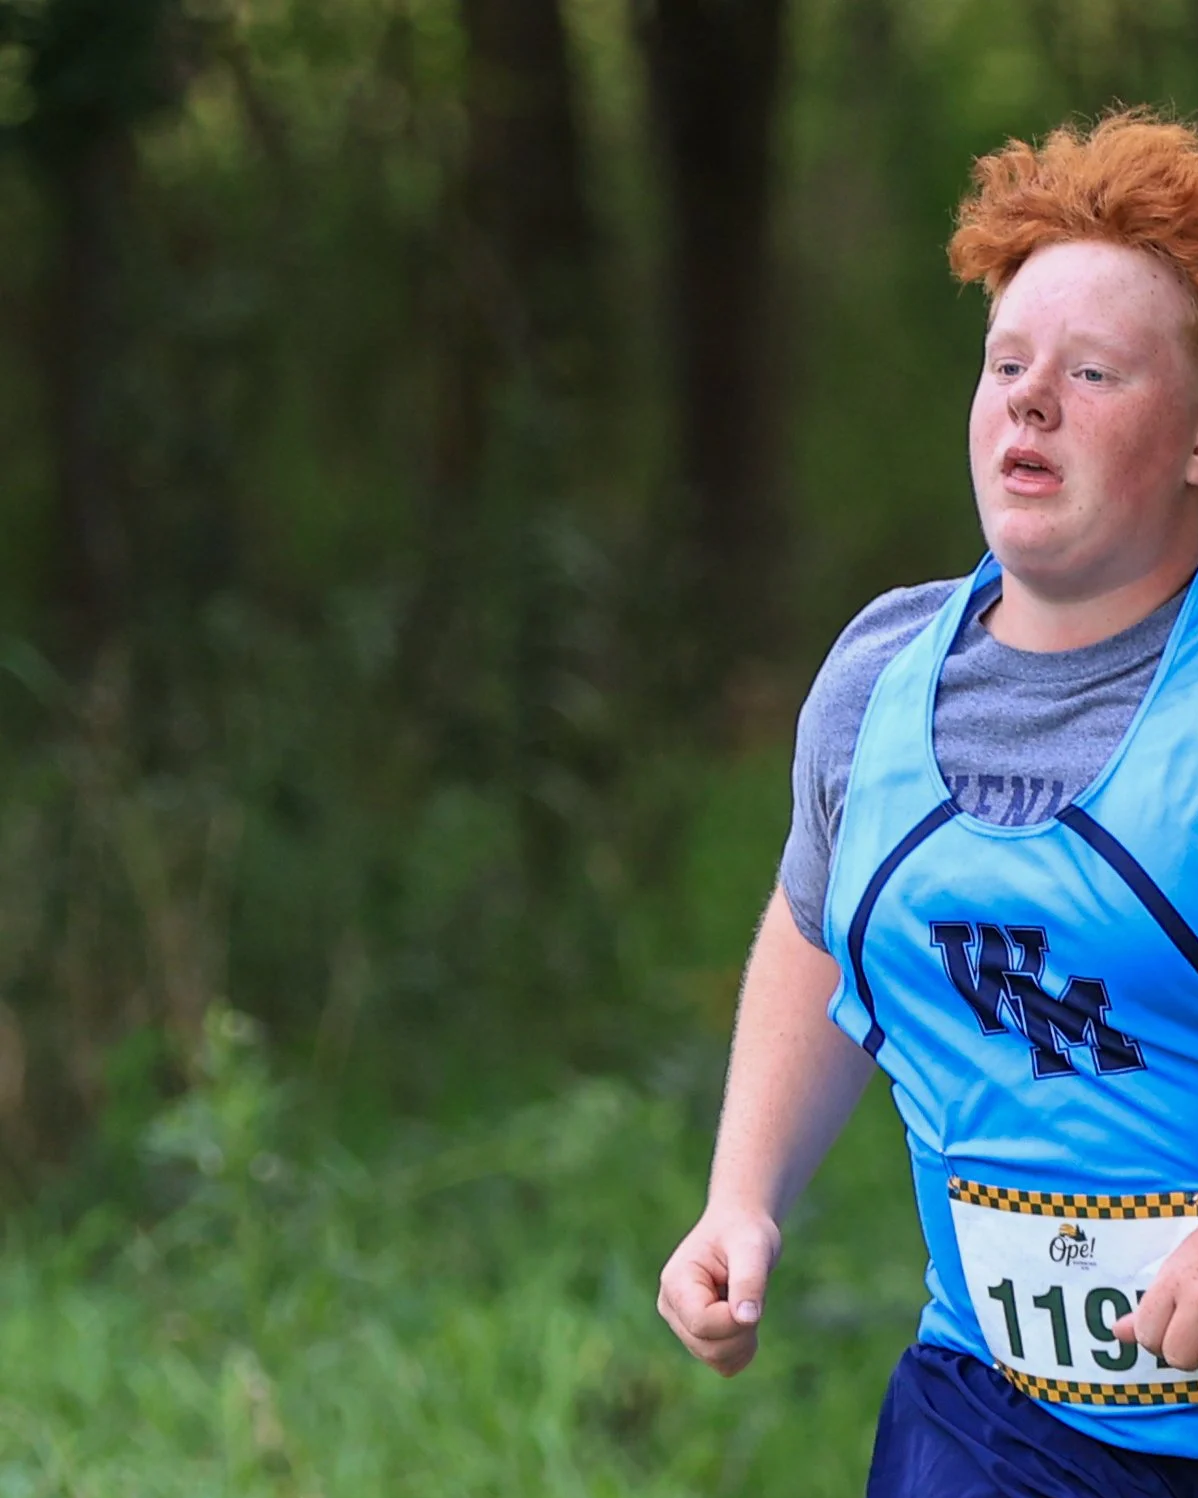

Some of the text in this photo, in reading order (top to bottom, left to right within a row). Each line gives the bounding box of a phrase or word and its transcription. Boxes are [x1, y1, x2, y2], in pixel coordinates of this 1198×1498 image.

[930, 921, 1147, 1080] WM
[1049, 1236, 1096, 1267] Ope!
[988, 1278, 1172, 1371] 119
